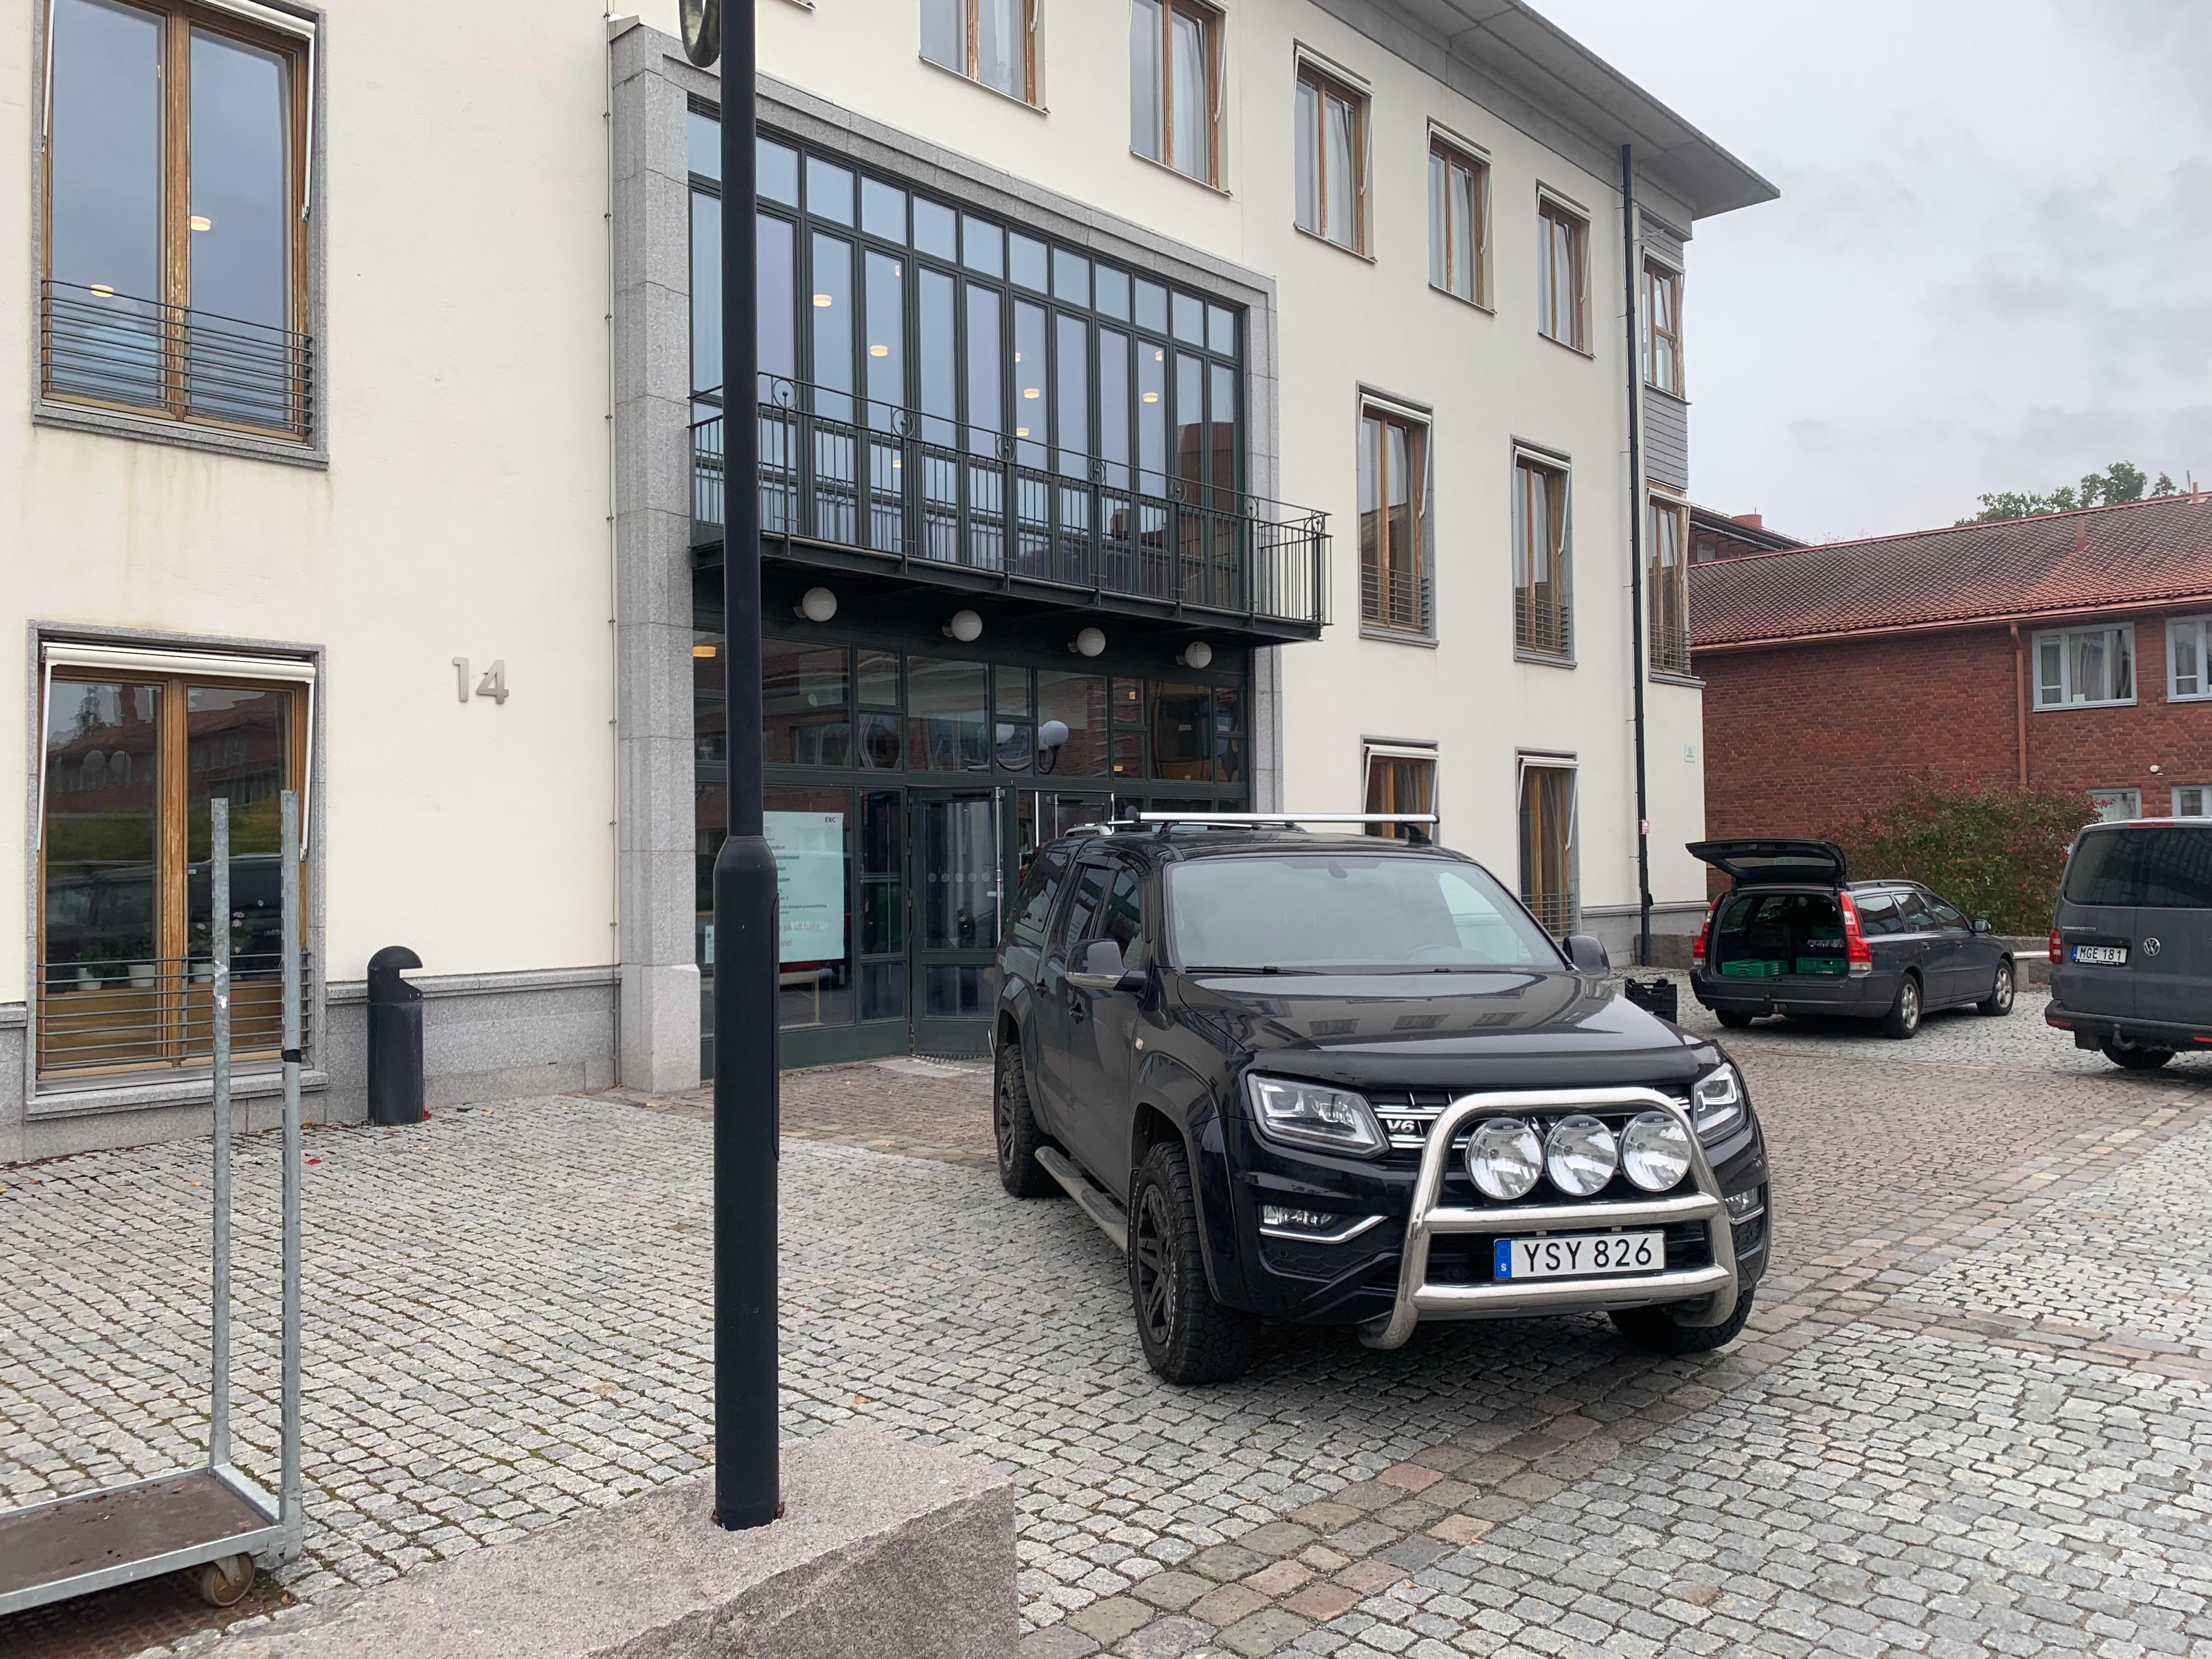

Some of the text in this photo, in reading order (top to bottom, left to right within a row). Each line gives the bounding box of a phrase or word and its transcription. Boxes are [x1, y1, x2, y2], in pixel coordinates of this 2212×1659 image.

[452, 657, 509, 704] 14
[2079, 947, 2121, 961] MGE 181
[1386, 1120, 1415, 1134] V6
[1523, 1241, 1582, 1272] YSY
[1594, 1238, 1652, 1268] 826
